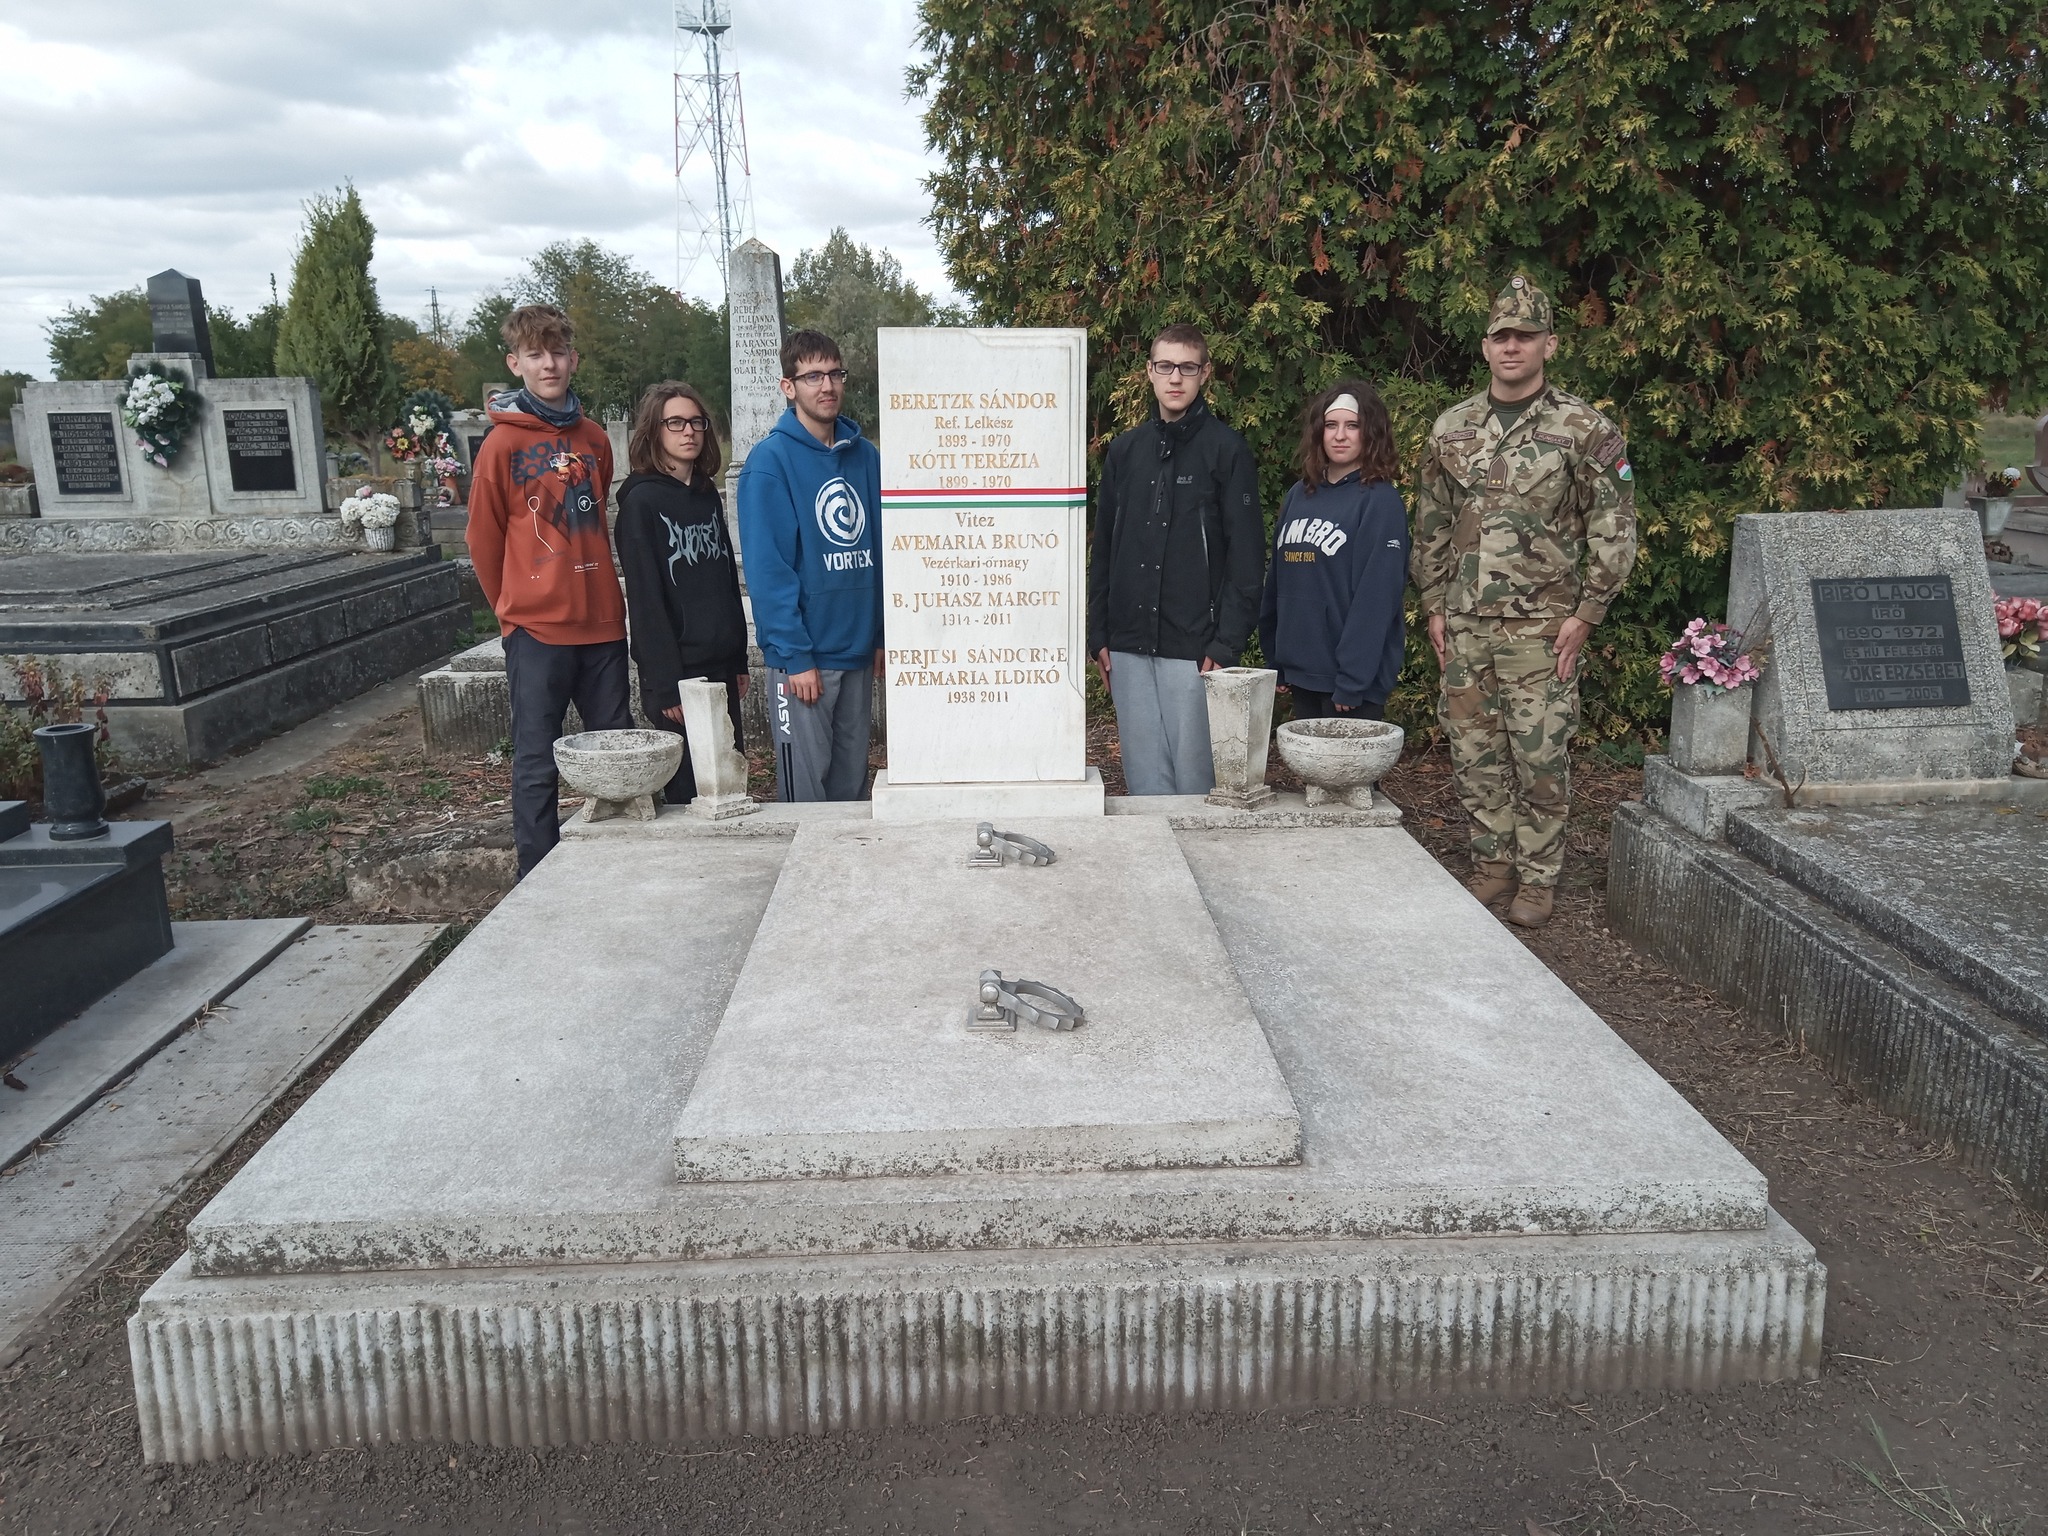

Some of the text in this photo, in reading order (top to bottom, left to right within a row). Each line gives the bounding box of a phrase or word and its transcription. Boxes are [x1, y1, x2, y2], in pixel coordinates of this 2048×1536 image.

[889, 388, 1058, 410] BERETZK SÁNDOR
[934, 415, 1014, 430] Ref. Lelkész
[937, 434, 968, 448] 1893
[981, 434, 1011, 448] 1970
[908, 449, 1040, 470] KÓTI TERÉZIA
[939, 475, 968, 489] 1899
[982, 475, 1012, 488] 1970
[891, 529, 1060, 551] AVEMARIA BRUNÓ
[822, 549, 874, 572] VORTEX
[1284, 551, 1302, 562] SINCE
[940, 574, 970, 587] 1910
[983, 573, 1012, 586] 1986
[893, 593, 909, 608] B.
[988, 591, 1061, 607] MARGIT
[1877, 584, 1946, 600] LAJOS
[983, 613, 1012, 626] 2011
[895, 665, 1060, 687] AVEMARIA ILDIKÓ
[947, 691, 1009, 704] 1938 2011
[776, 682, 791, 735] EASY
